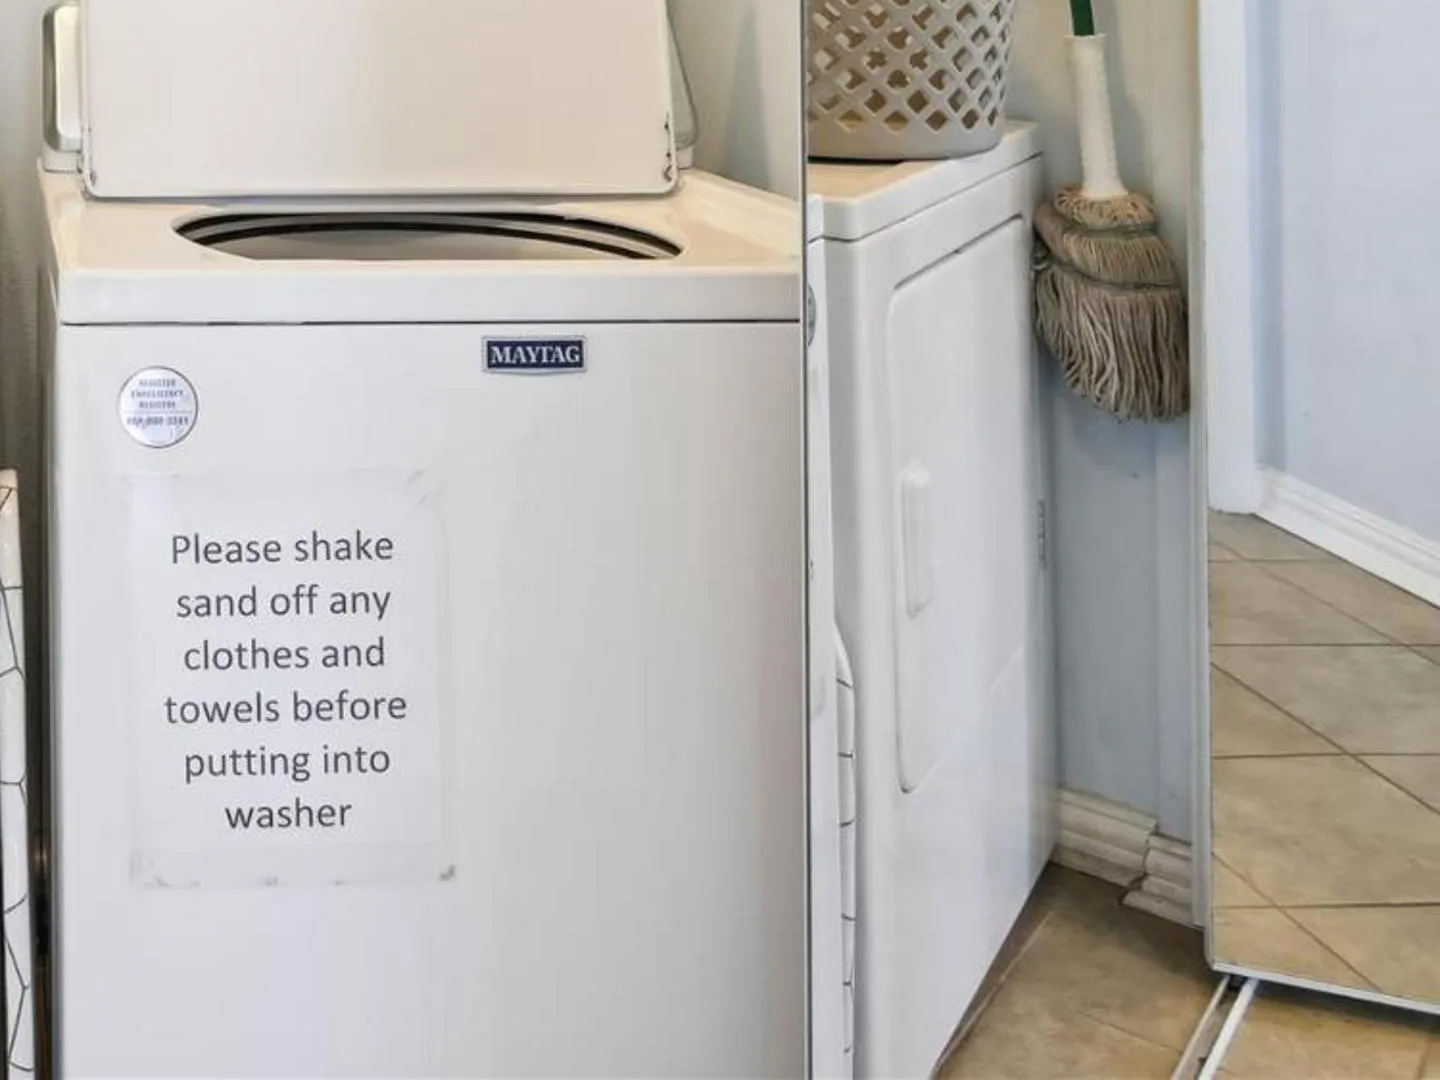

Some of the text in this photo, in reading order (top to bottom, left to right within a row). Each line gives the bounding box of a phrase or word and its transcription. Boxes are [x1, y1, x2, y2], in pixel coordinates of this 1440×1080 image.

[490, 345, 581, 365] MAYTAG
[172, 529, 394, 565] Please shake
[176, 583, 391, 622] sand off any
[183, 635, 385, 671] clothes and
[163, 688, 407, 725] towels before
[185, 743, 391, 785] putting into
[224, 796, 353, 830] washer
